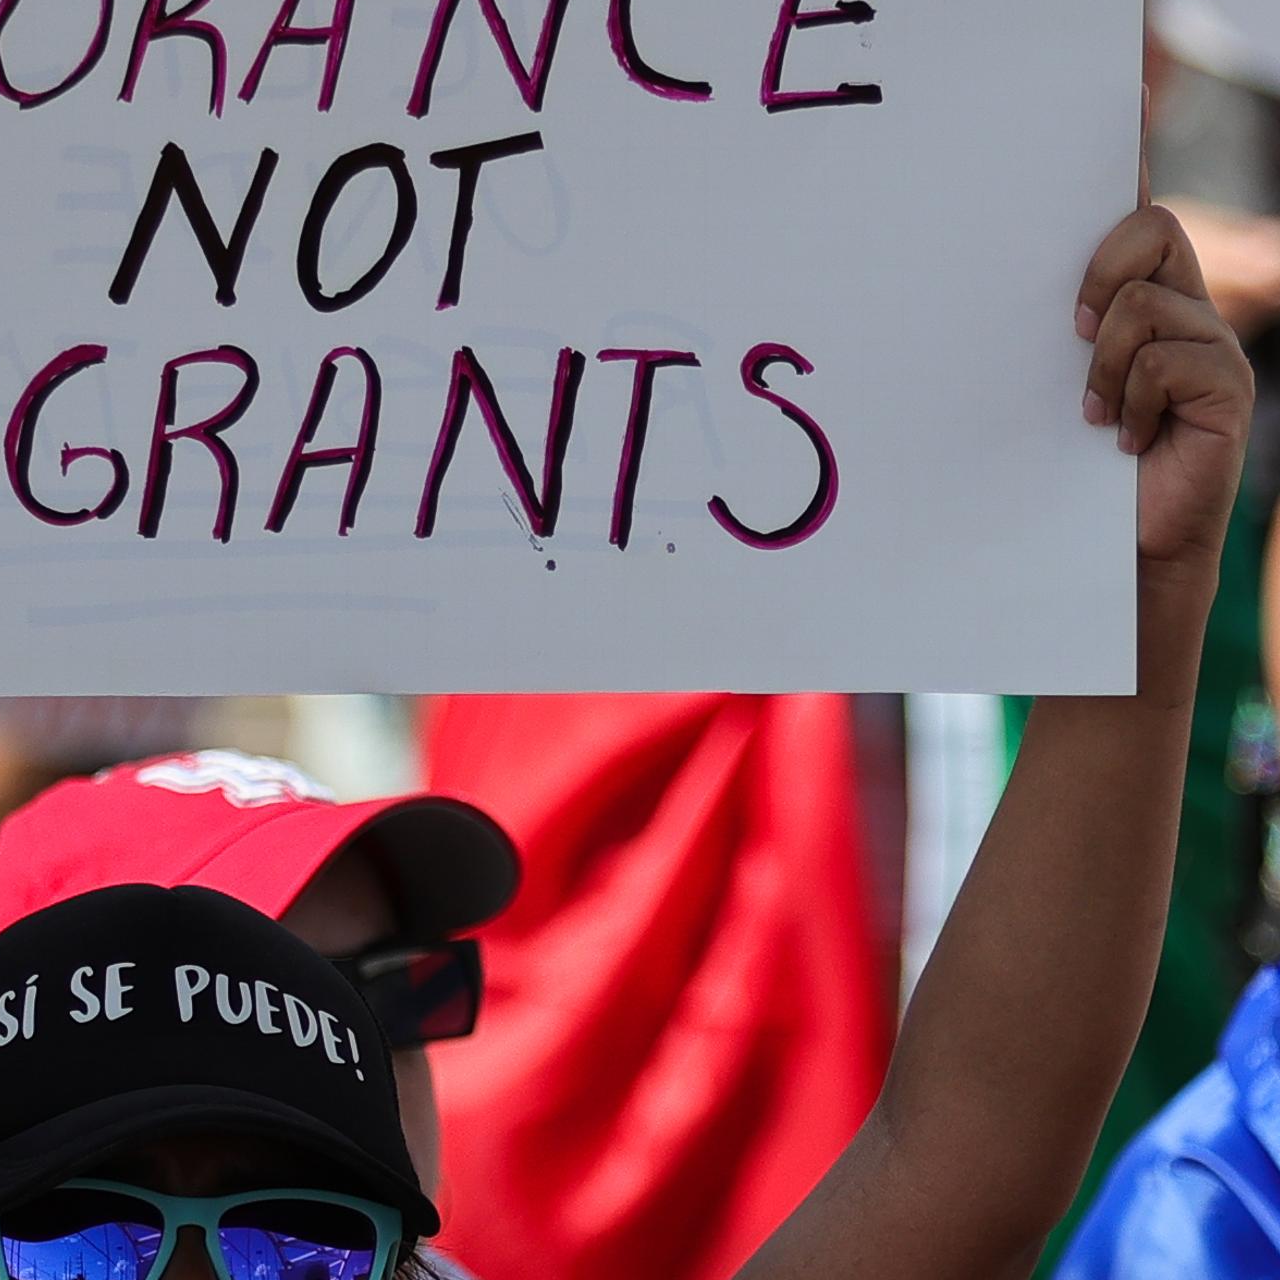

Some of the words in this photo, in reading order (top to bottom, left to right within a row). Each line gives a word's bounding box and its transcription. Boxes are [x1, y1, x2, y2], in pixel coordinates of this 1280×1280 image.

[108, 130, 543, 313] NOT
[69, 962, 137, 1024] SE
[174, 964, 365, 1082] PUEDE!
